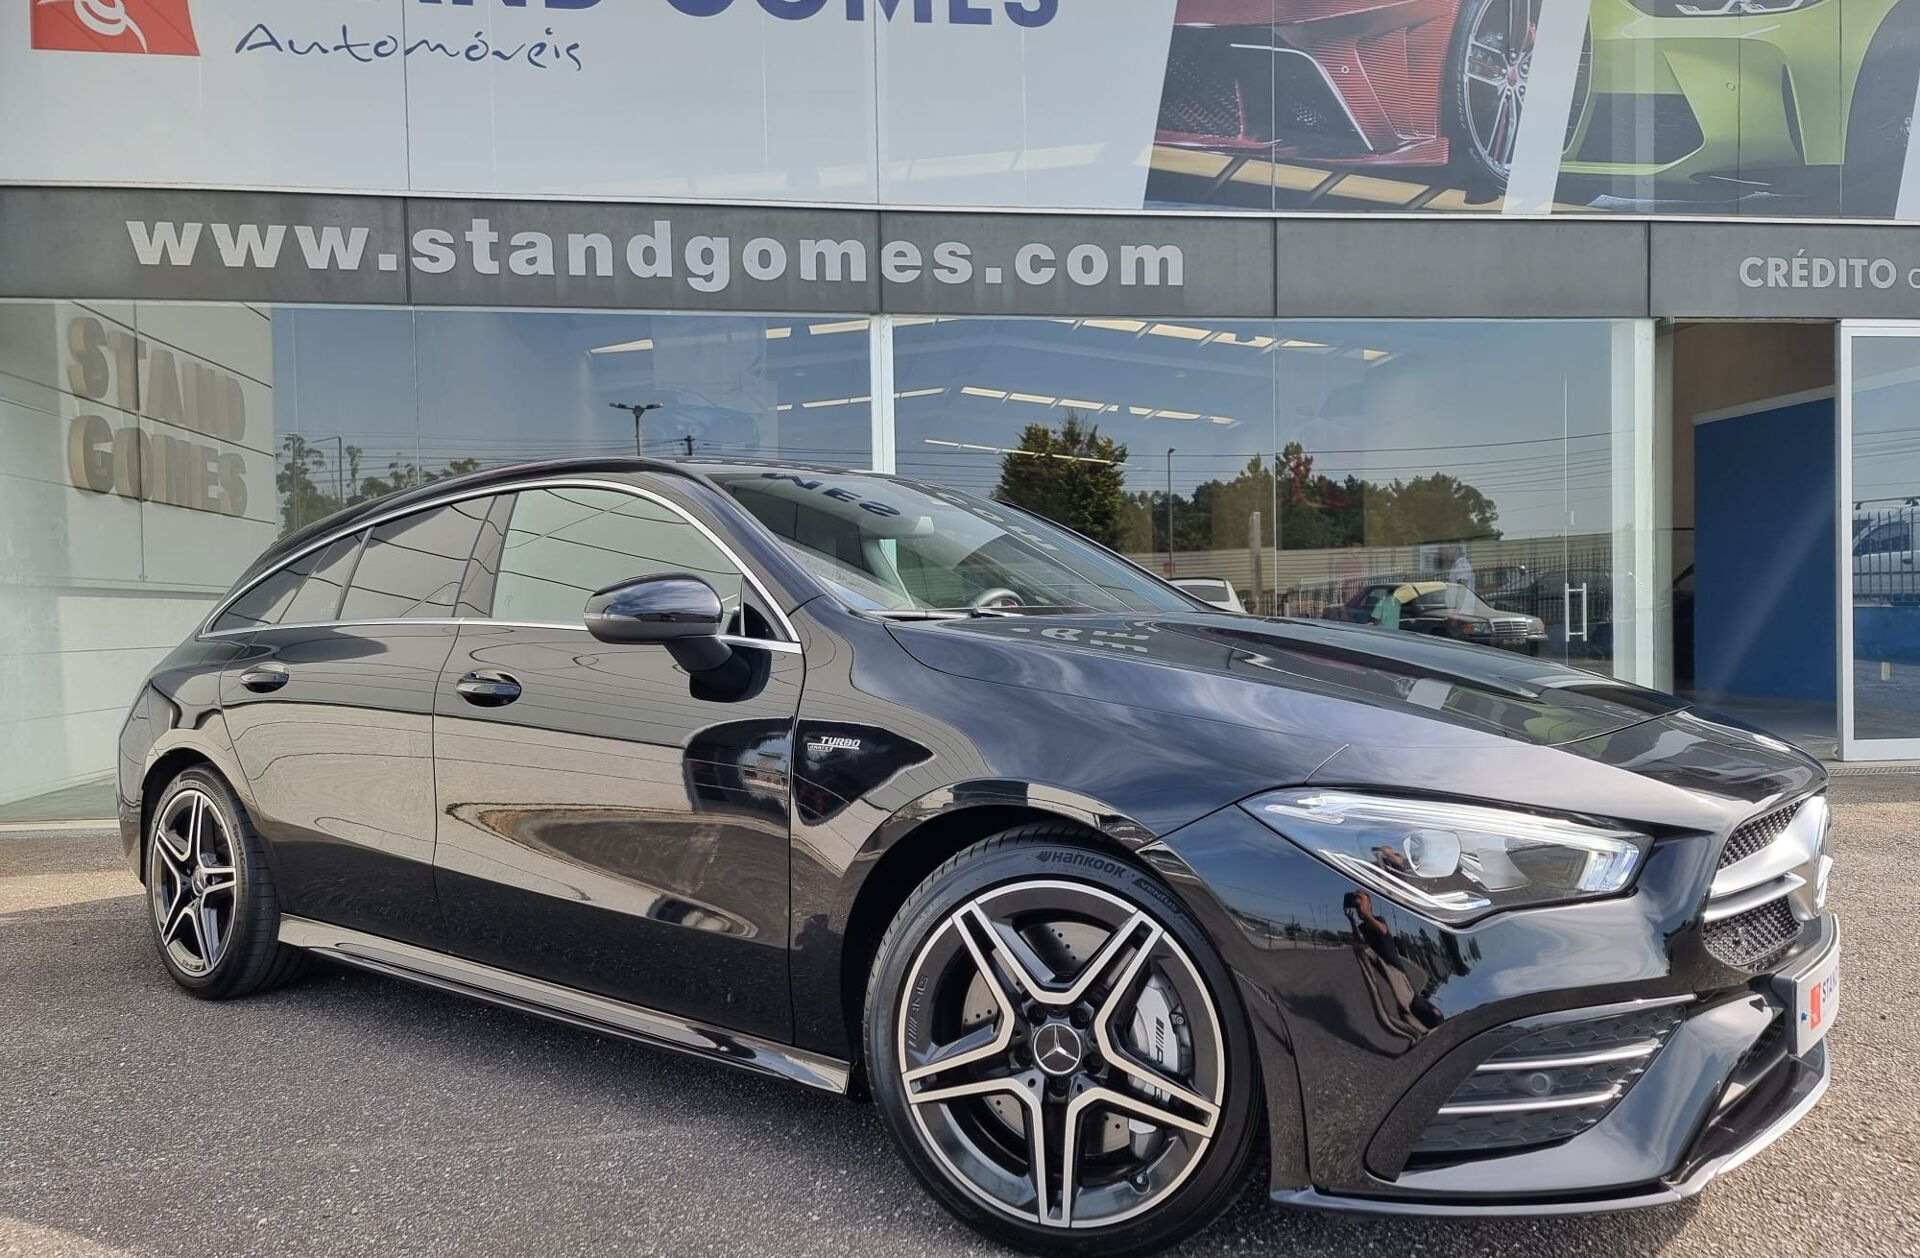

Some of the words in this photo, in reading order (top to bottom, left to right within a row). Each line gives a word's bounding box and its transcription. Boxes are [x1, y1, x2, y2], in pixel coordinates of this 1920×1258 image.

[234, 23, 582, 72] Automóveis
[125, 218, 1184, 293] www.standgomes.com
[1739, 248, 1897, 289] CRÉDITO
[68, 316, 246, 442] STAND
[68, 414, 248, 518] GOMES
[820, 736, 861, 748] TURBO
